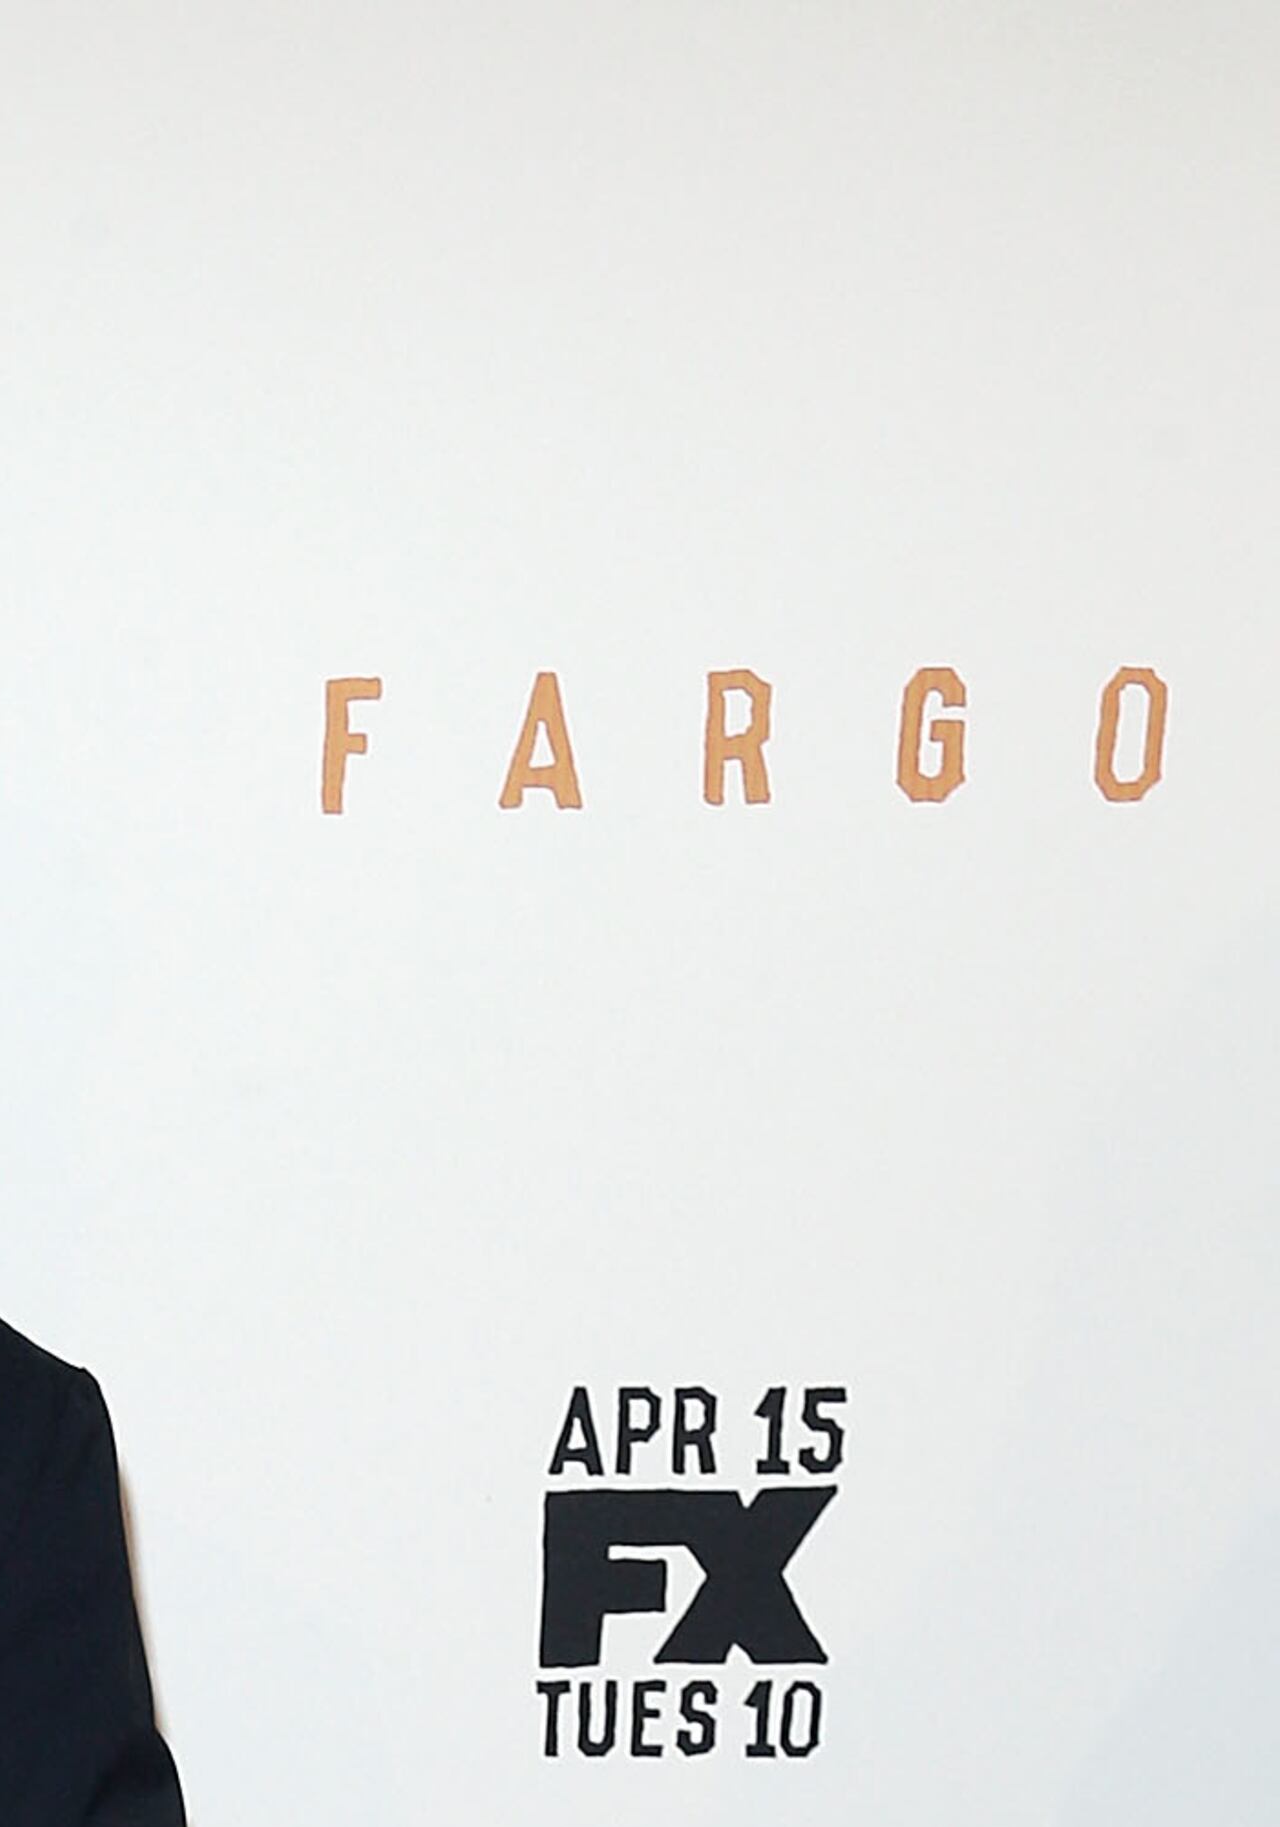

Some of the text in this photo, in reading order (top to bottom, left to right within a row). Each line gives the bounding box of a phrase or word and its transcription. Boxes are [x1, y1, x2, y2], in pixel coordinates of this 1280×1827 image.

[321, 666, 1168, 815] FARGO
[548, 1386, 848, 1476] APR 15
[539, 1484, 839, 1669] FX
[536, 1679, 823, 1758] TUES 10
